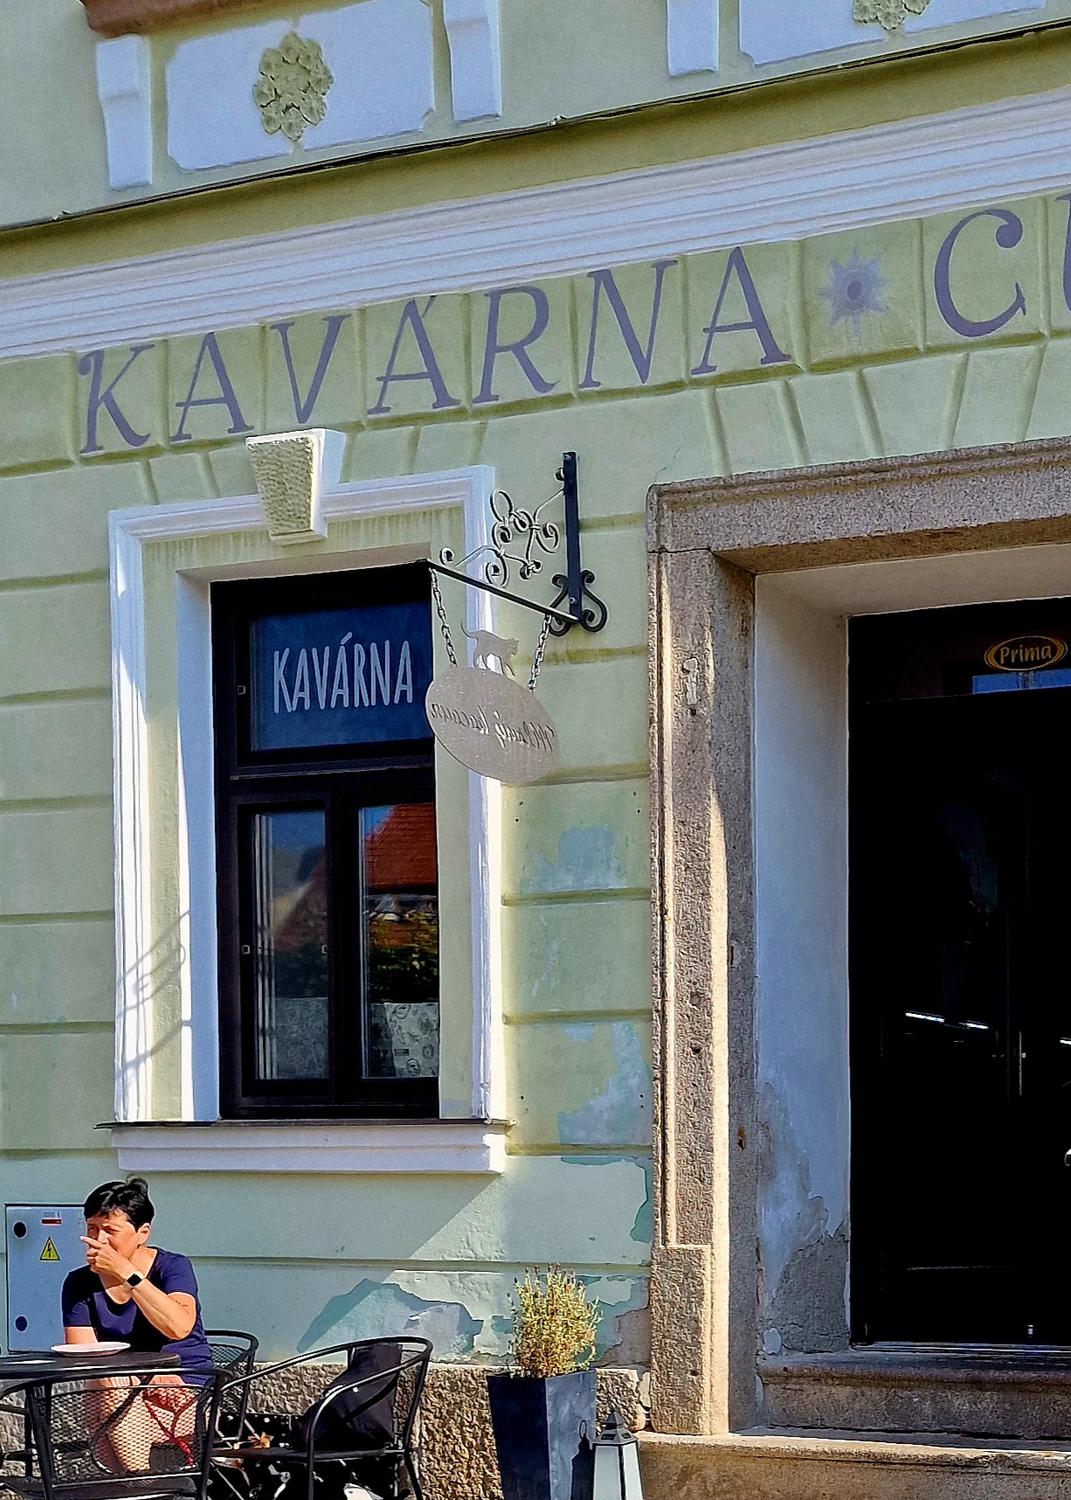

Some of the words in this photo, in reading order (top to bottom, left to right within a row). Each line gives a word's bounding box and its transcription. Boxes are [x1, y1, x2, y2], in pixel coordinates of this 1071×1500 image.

[78, 246, 792, 454] KAVÁRNA
[273, 632, 414, 714] KAVÁRNA
[1000, 644, 1052, 665] Prima
